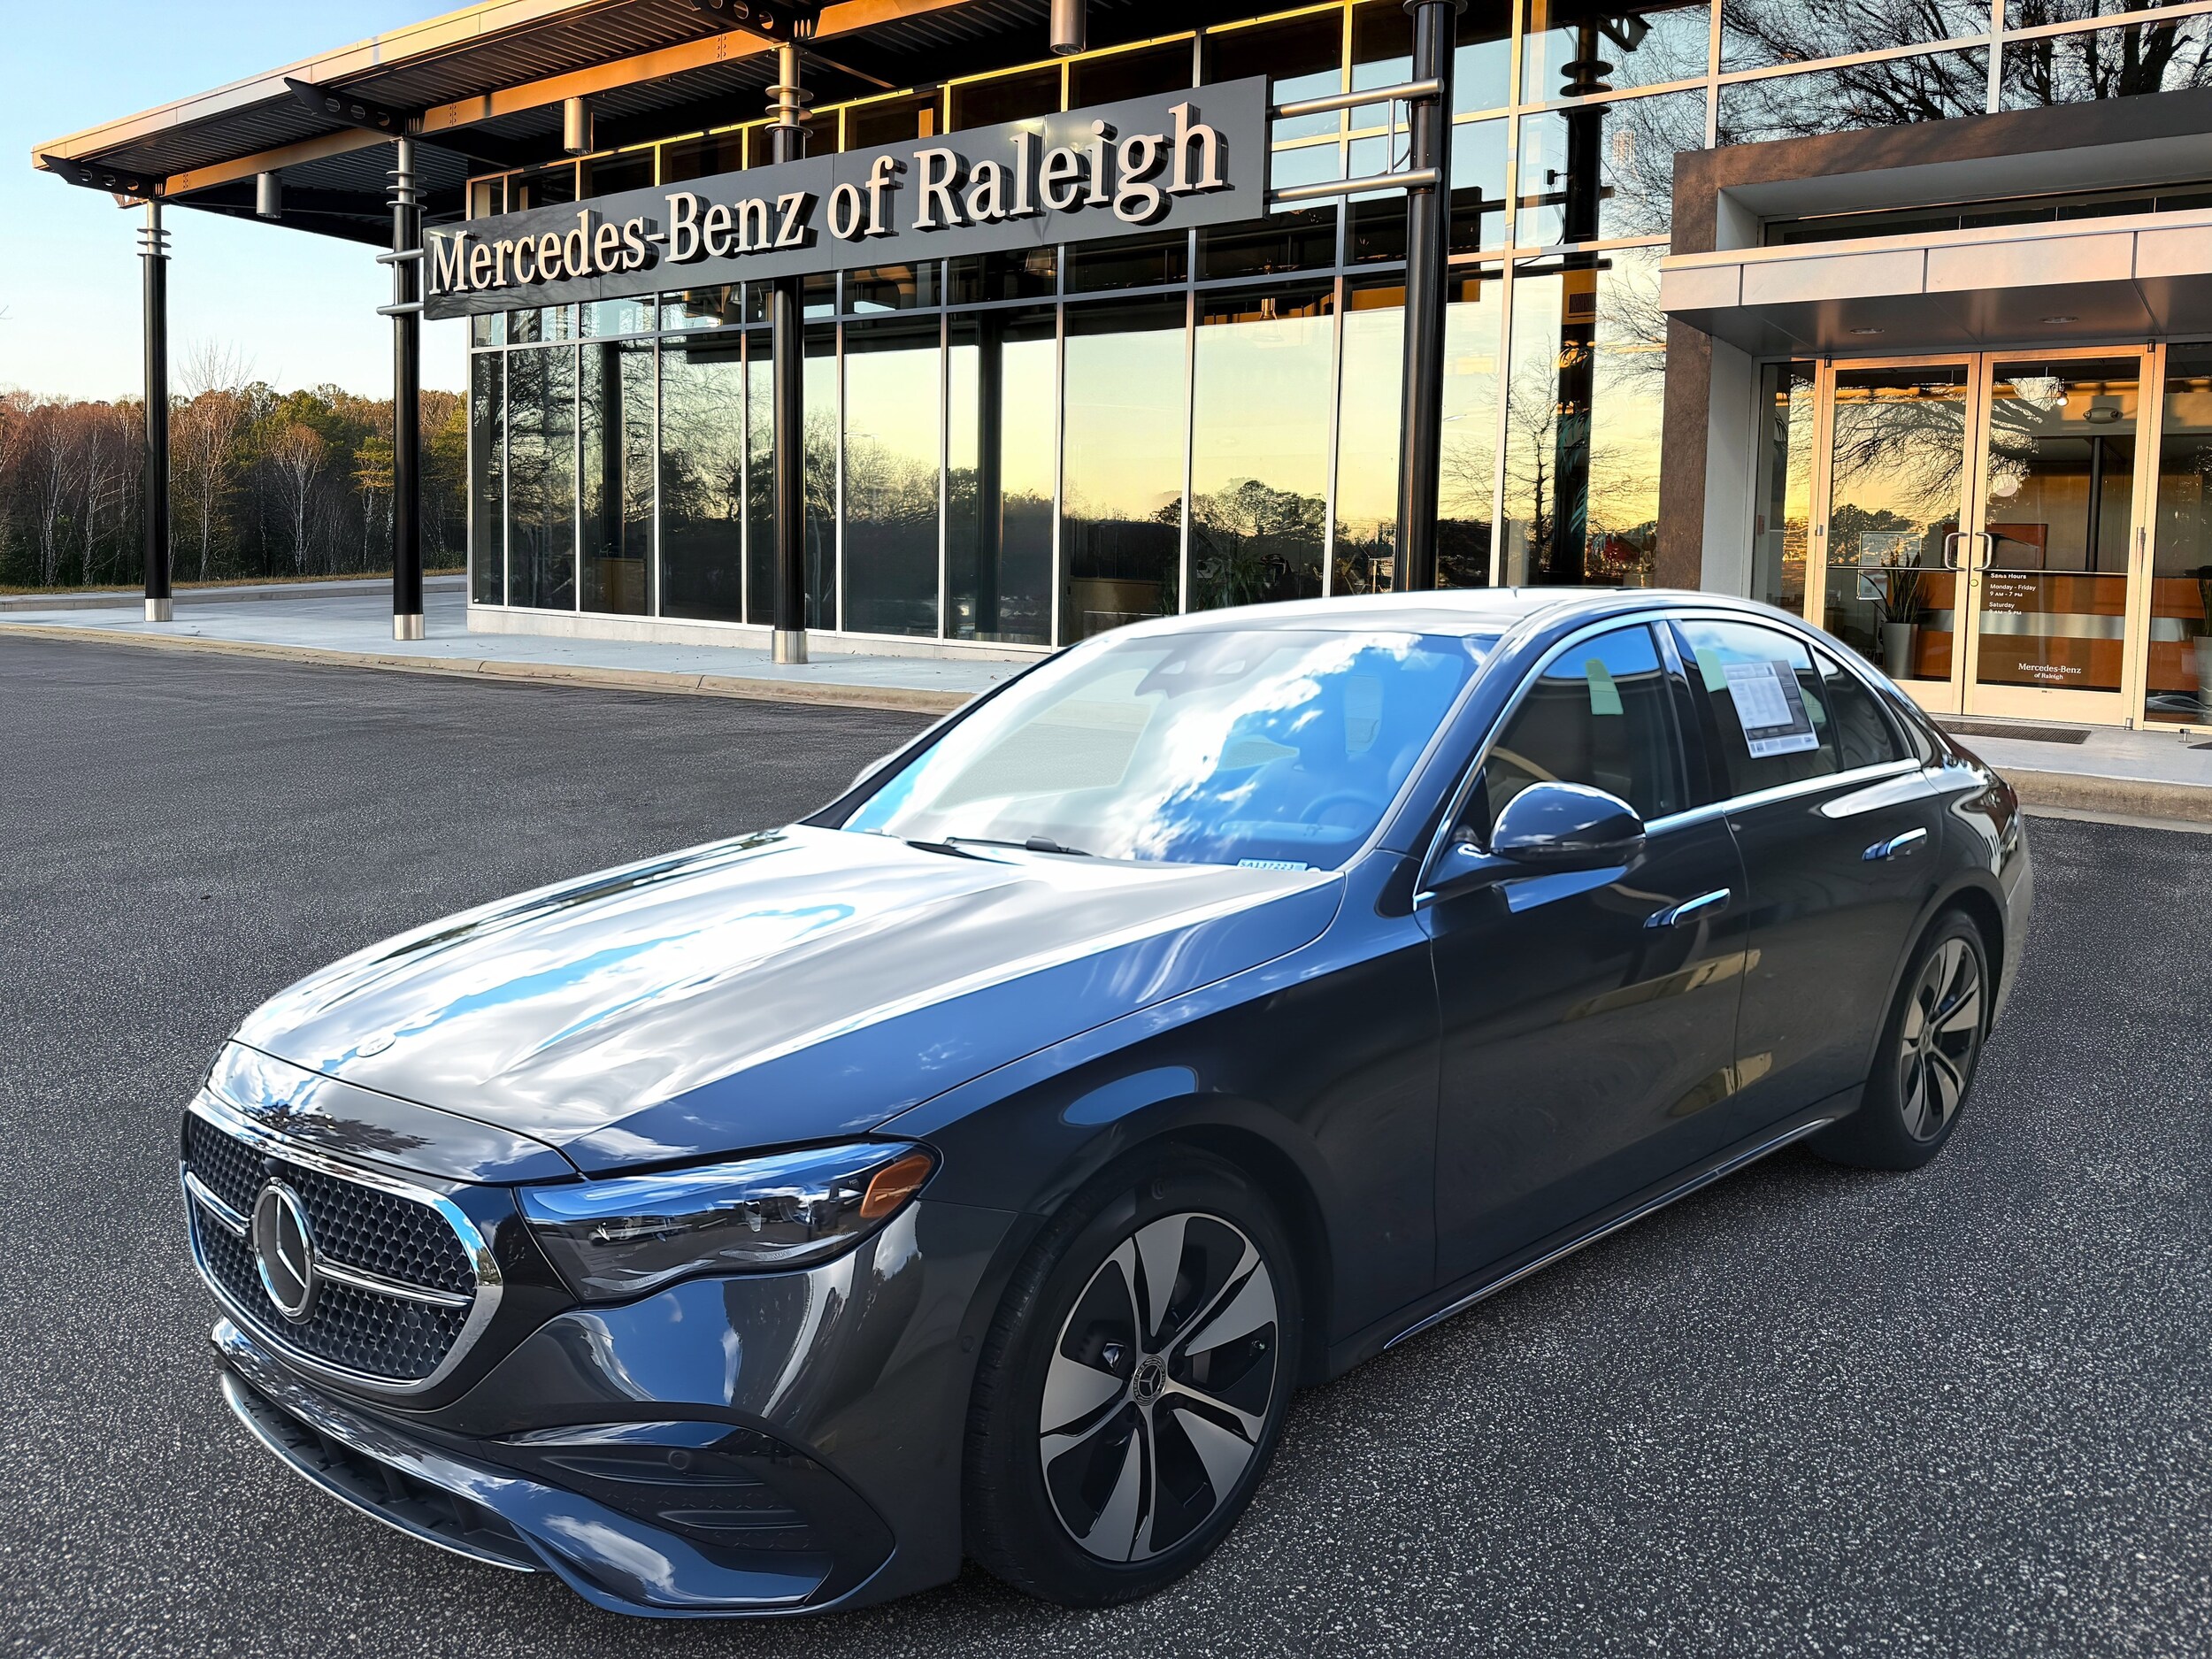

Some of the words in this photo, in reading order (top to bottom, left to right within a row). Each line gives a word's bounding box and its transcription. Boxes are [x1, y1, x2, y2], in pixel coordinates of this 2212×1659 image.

[428, 191, 807, 296] Mercedes-Benz
[826, 155, 895, 240] of
[911, 101, 1225, 228] Raleigh
[2018, 663, 2081, 674] Mercedes-Benz
